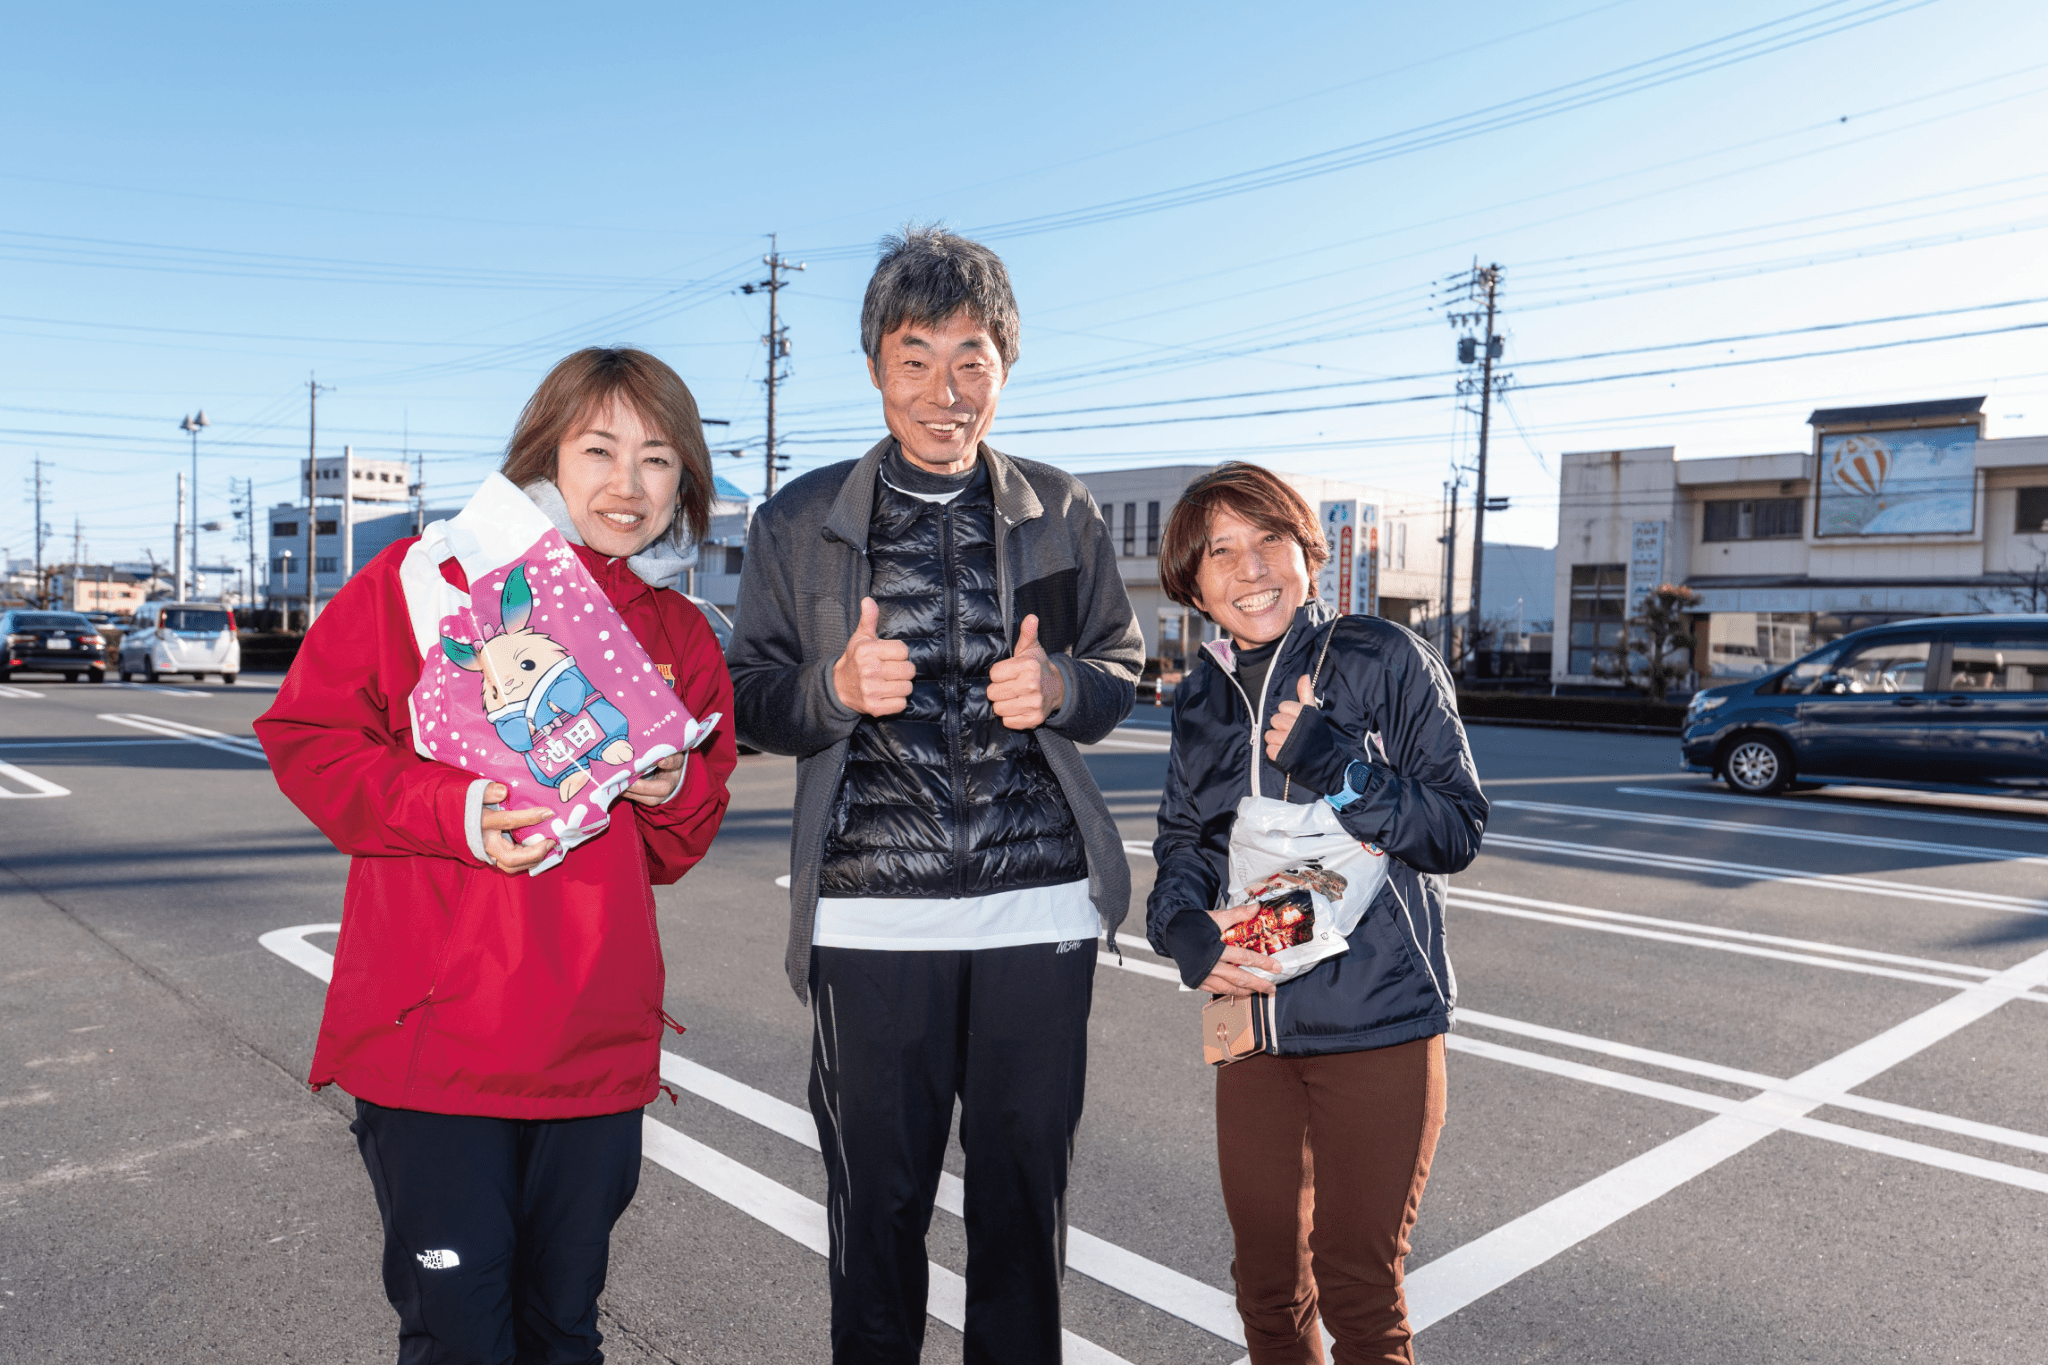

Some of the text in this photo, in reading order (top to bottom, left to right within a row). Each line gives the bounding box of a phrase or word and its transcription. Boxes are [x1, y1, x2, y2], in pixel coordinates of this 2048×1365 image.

[536, 718, 597, 772] 池田
[416, 1253, 443, 1263] NORTH
[424, 1249, 442, 1257] THE
